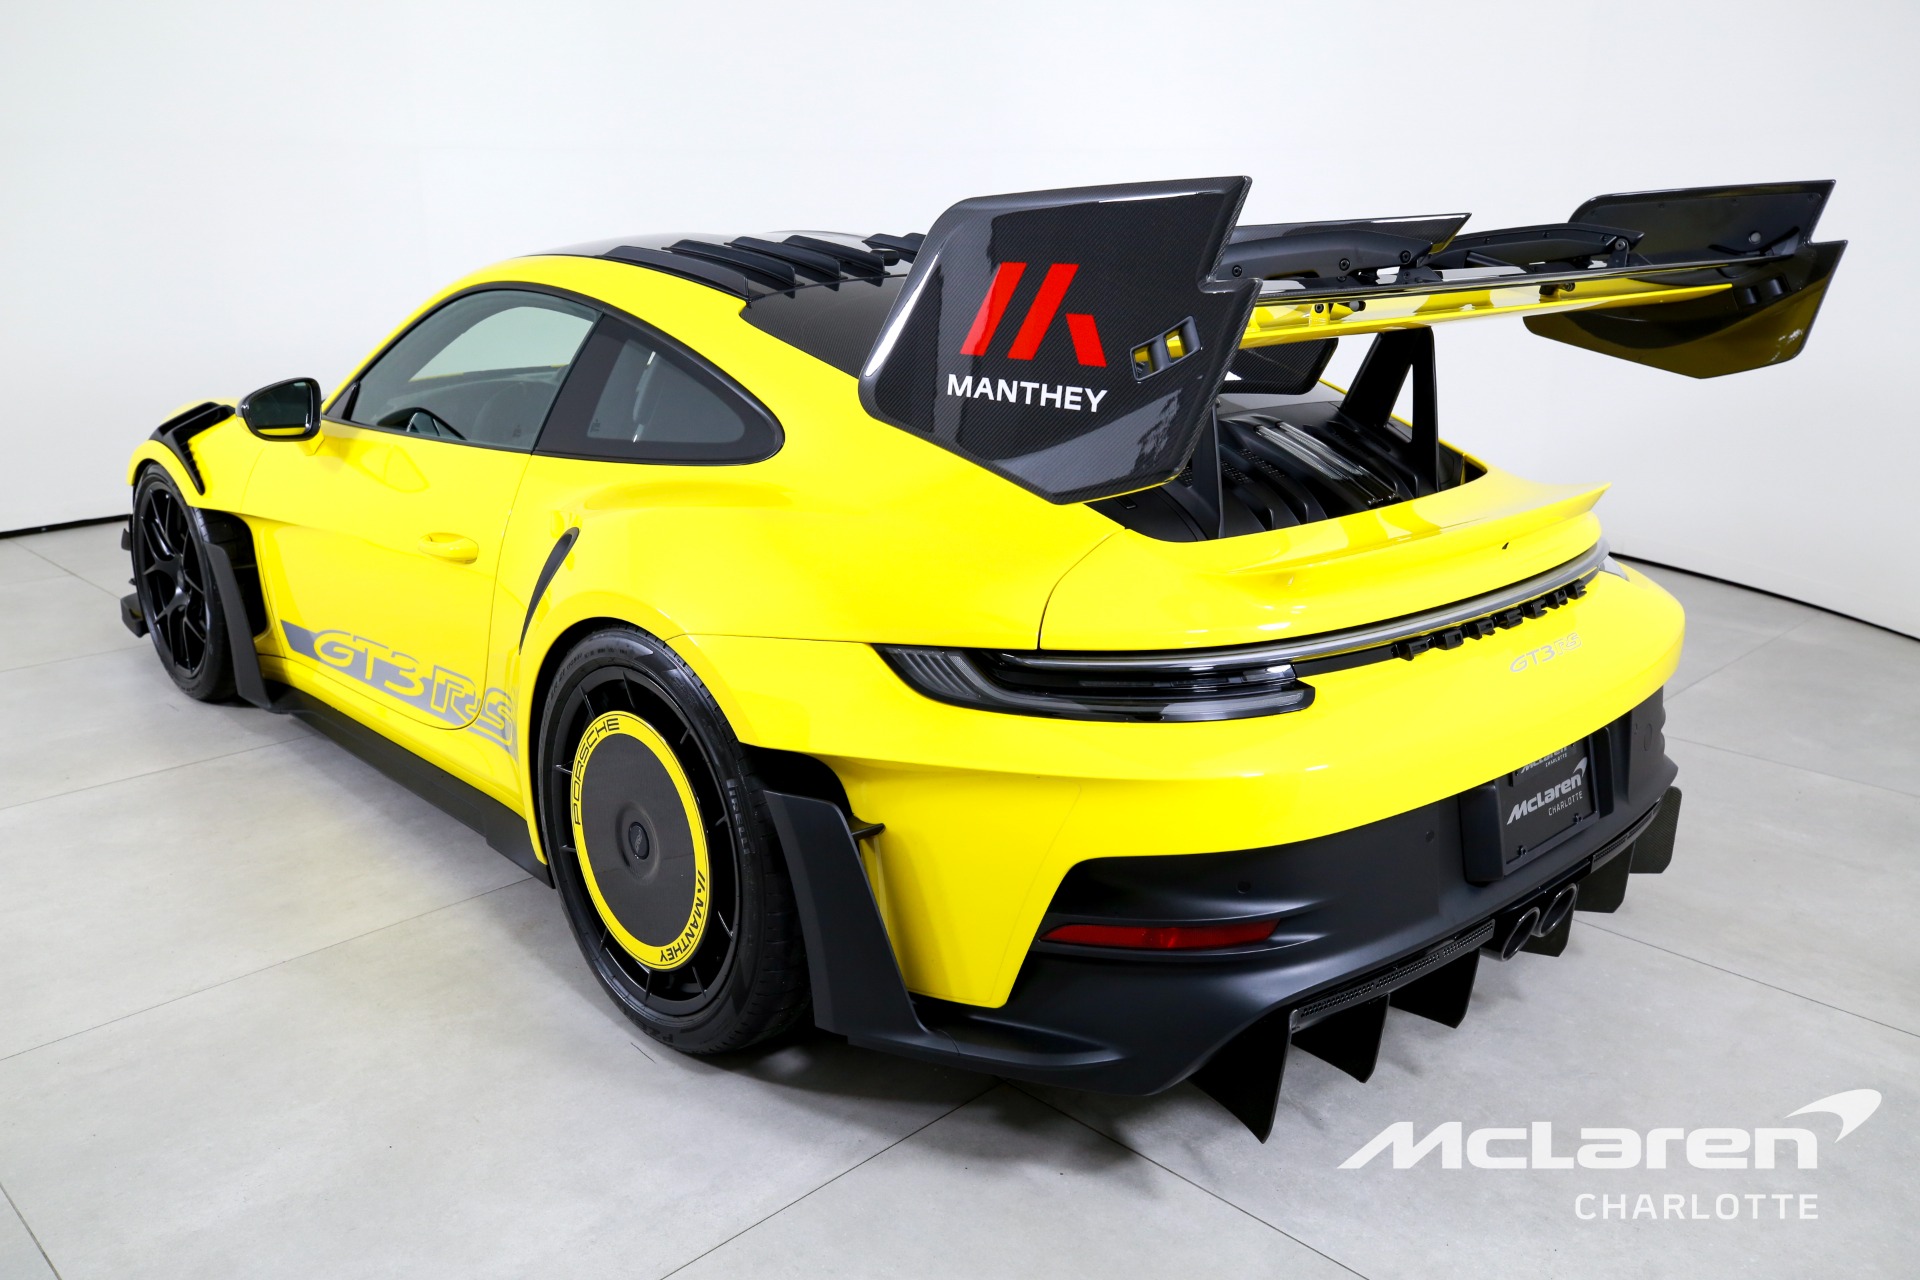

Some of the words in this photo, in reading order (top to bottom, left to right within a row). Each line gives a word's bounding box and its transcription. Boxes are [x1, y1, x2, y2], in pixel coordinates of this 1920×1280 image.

[947, 373, 1108, 413] MANTHEY
[573, 718, 620, 825] PORSCHE
[1506, 773, 1582, 825] McLaren
[1548, 790, 1583, 817] CHARLOTTE
[659, 896, 705, 962] MANTHEY
